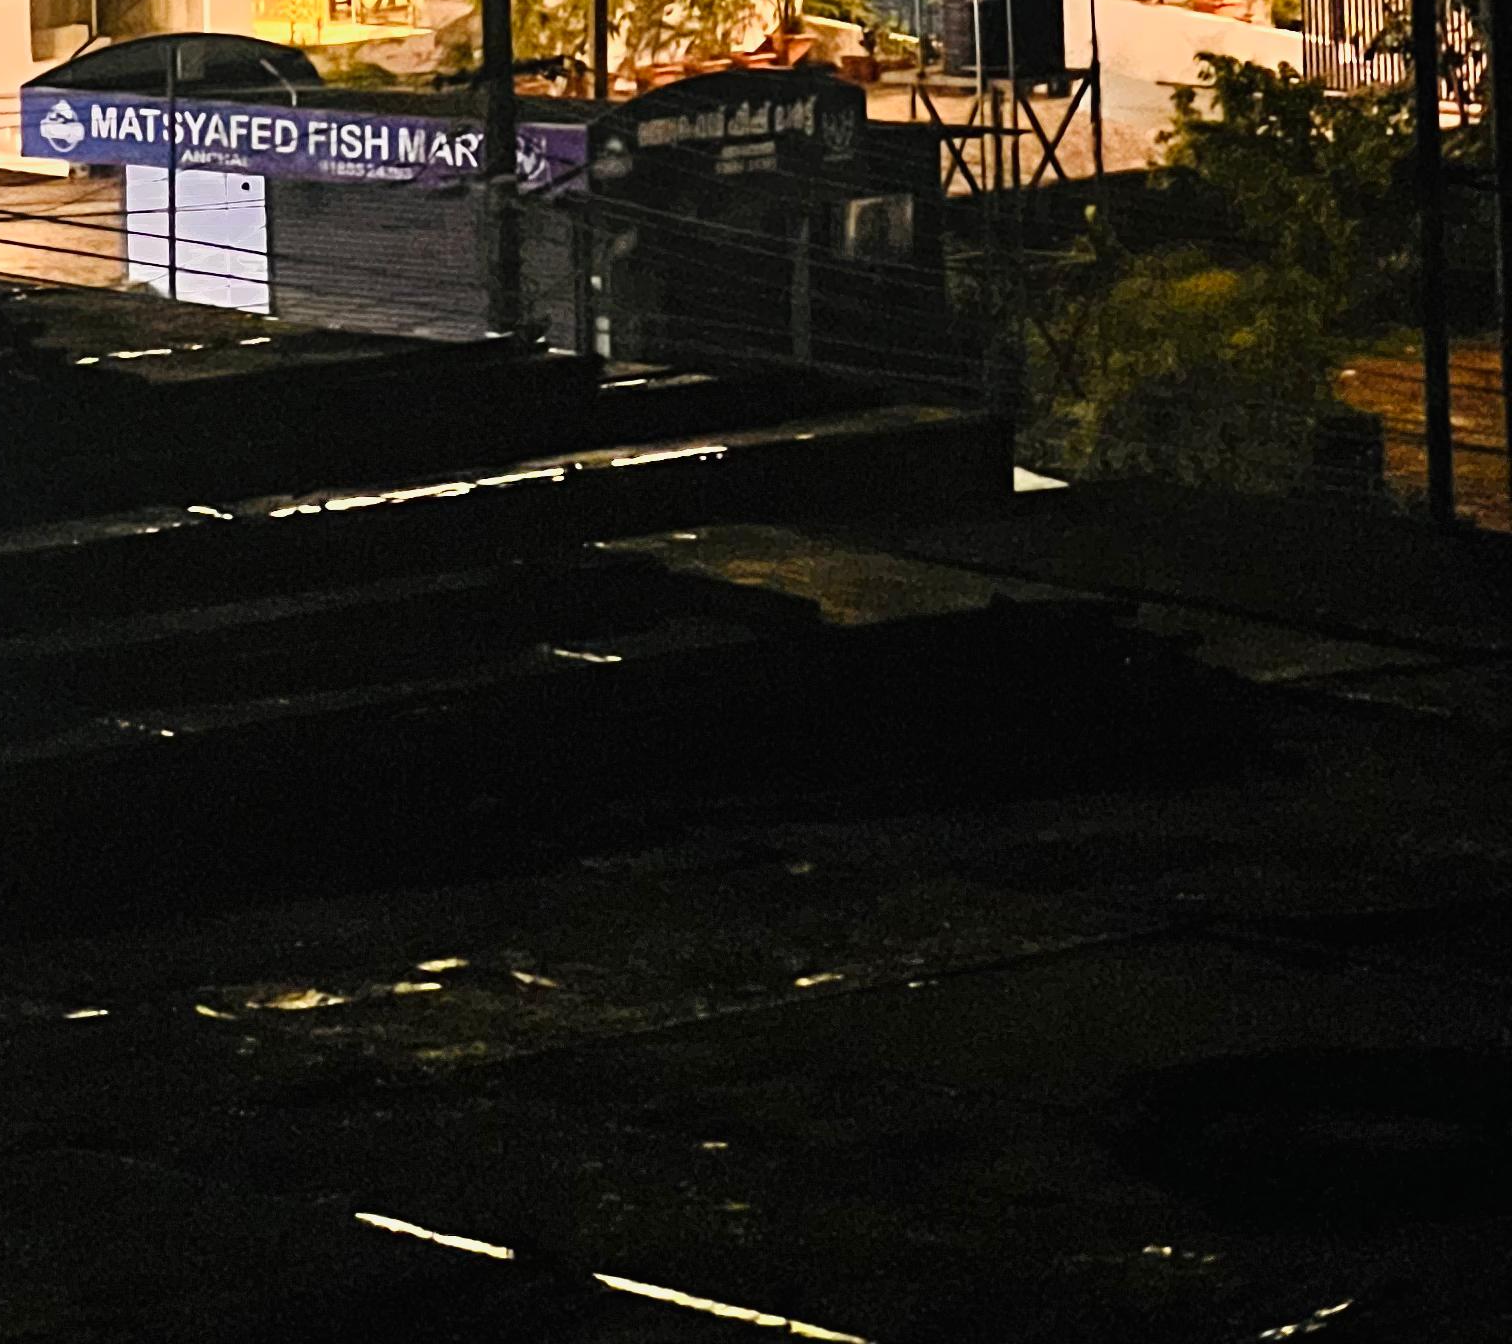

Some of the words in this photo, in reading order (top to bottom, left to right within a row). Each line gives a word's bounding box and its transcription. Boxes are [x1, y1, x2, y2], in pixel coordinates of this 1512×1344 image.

[90, 103, 299, 154] MATSYAFED
[307, 120, 389, 161] FISH
[398, 127, 485, 168] MAR
